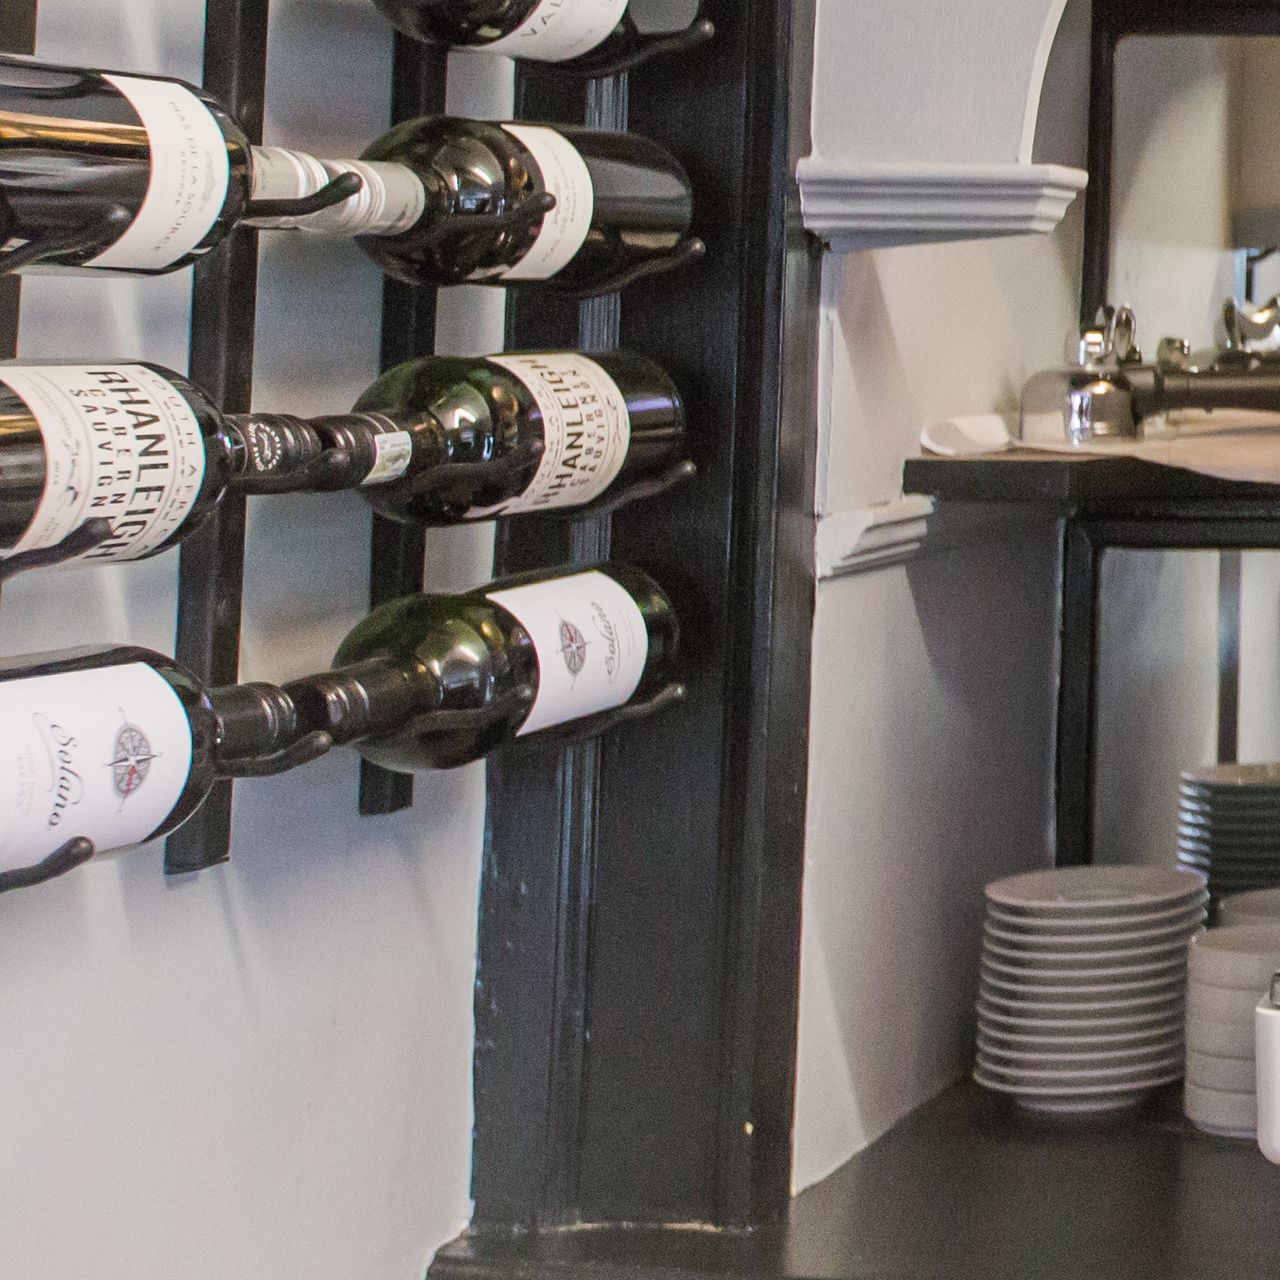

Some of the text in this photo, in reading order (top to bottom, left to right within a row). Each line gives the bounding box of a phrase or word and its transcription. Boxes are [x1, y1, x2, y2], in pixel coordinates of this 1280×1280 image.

[70, 389, 113, 507] SAUVIGN
[88, 388, 132, 505] CABERN
[48, 723, 84, 826] Solano
